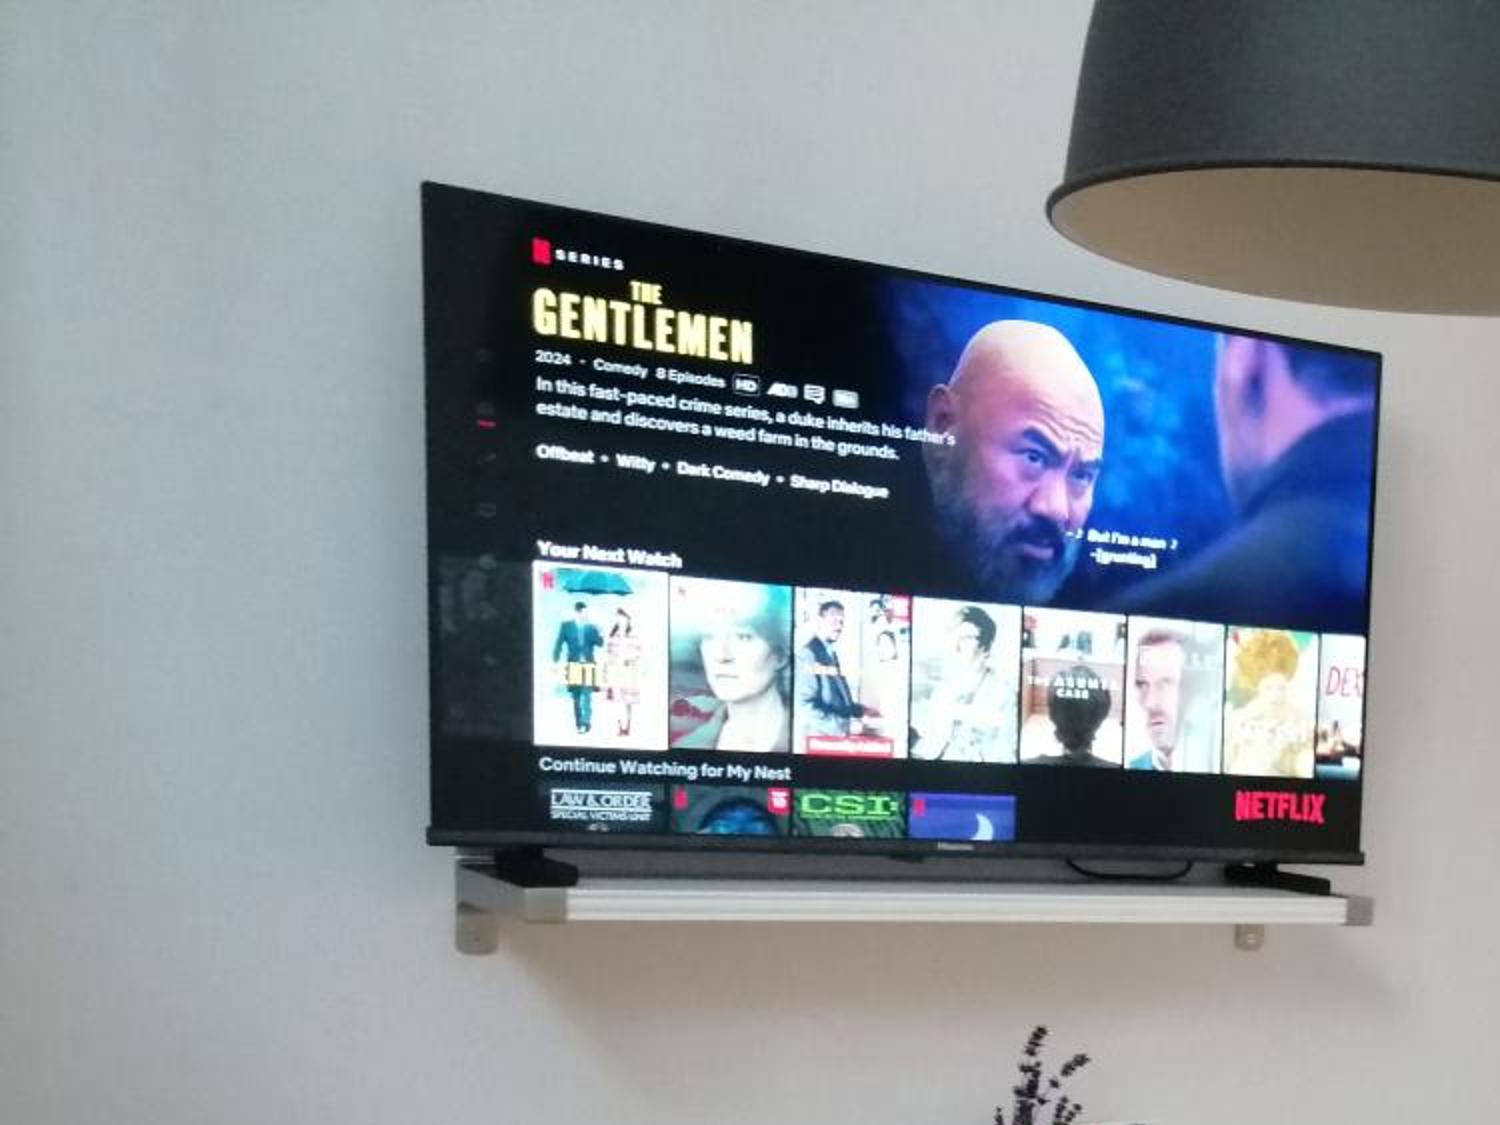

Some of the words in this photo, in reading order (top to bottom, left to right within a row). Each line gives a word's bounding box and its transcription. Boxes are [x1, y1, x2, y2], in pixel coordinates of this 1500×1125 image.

[555, 249, 625, 270] SERIES
[630, 280, 662, 305] THE
[533, 288, 753, 364] GENTLEMEN
[535, 349, 572, 366] 2024
[593, 358, 649, 379] Comedy
[655, 367, 667, 380] 8
[668, 369, 727, 389] Episodes
[536, 376, 553, 392] In
[555, 379, 587, 397] this
[588, 383, 677, 408] fast-paced
[679, 398, 722, 415] crime
[725, 405, 774, 424] series,
[775, 412, 787, 423] a
[788, 411, 826, 428] duke
[827, 415, 880, 436] inherits
[881, 422, 904, 438] his
[904, 426, 956, 446] father's
[536, 402, 588, 420] estate
[590, 410, 622, 425] and
[624, 411, 700, 436] discovers
[702, 424, 712, 436] a
[714, 425, 757, 442] weed
[758, 428, 793, 446] farm
[794, 434, 809, 448] in
[811, 436, 835, 451] the
[837, 442, 900, 460] grounds.
[536, 443, 595, 464] Offbeat
[615, 453, 656, 473] Witty
[677, 461, 711, 477] Dark
[712, 465, 771, 487] Comedy
[790, 474, 831, 493] Sharp
[832, 479, 889, 498] Dialogue
[536, 540, 580, 559] Your
[582, 544, 625, 563] Next
[627, 549, 683, 568] Watch
[539, 757, 617, 774] Continue
[620, 760, 697, 780] Watching
[700, 763, 724, 779] for
[726, 765, 751, 782] My
[755, 767, 792, 781] Nest
[1235, 790, 1325, 824] NETFLIX
